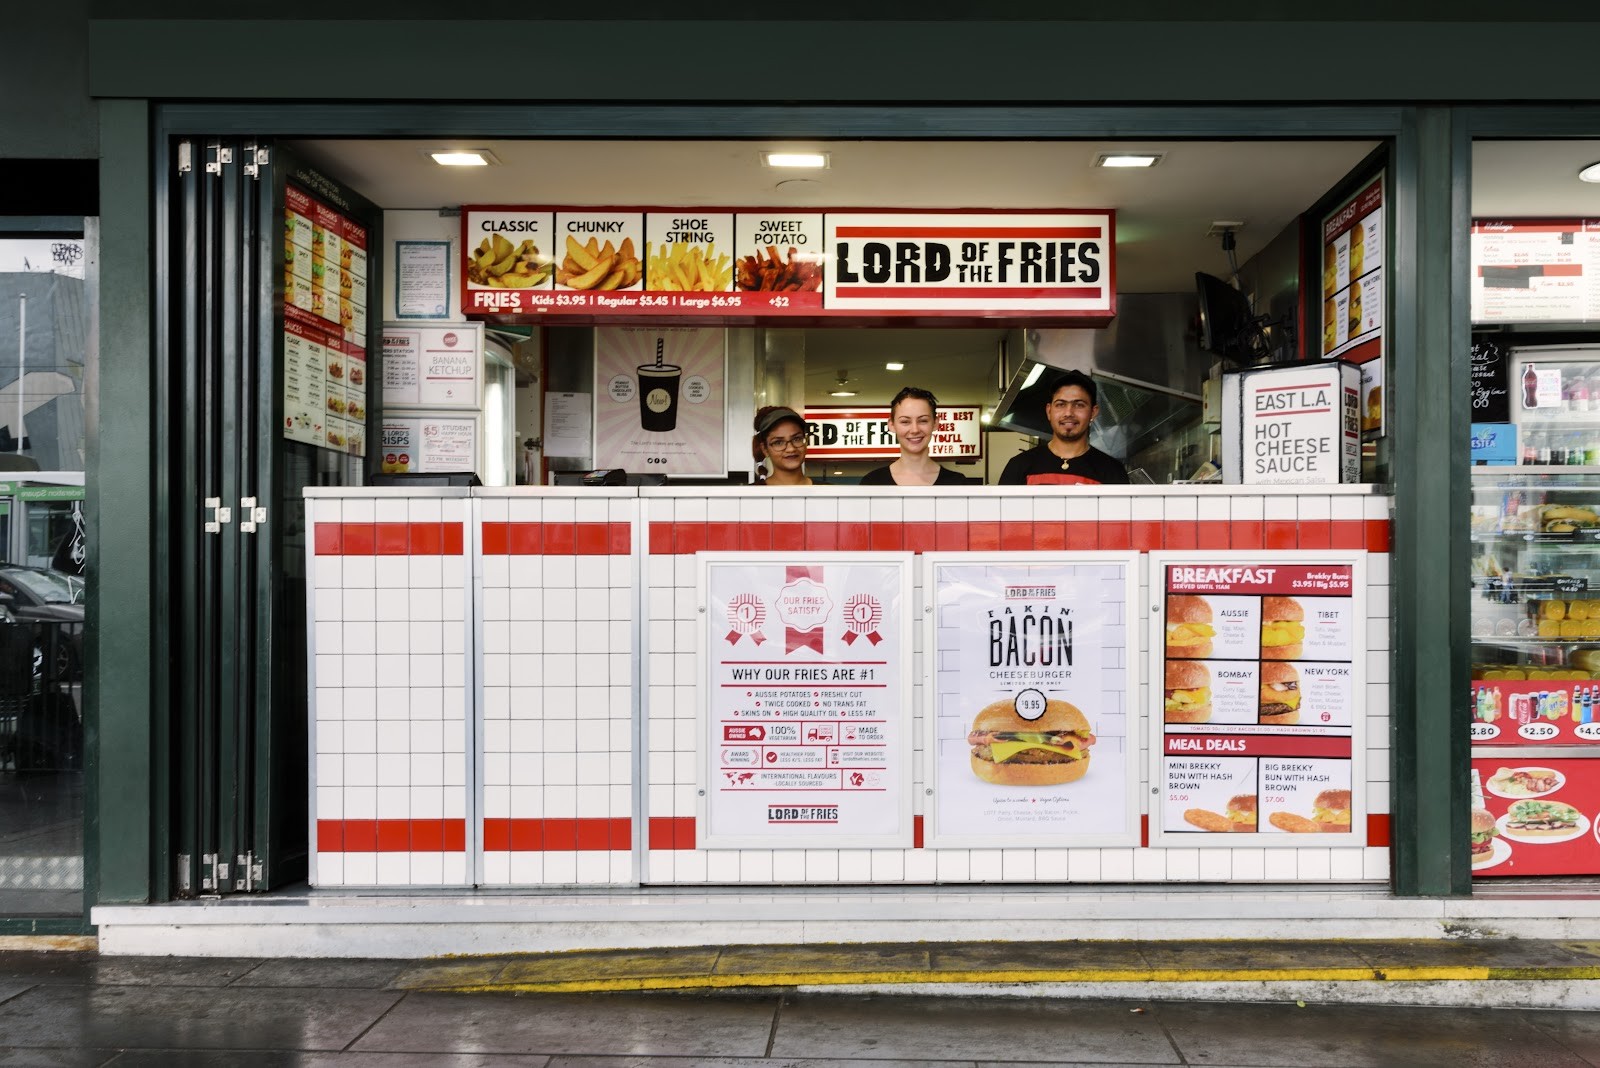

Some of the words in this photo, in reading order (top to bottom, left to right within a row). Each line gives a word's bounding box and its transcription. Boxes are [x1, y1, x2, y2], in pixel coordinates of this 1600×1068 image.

[1326, 202, 1357, 232] BREAKFAST
[482, 220, 538, 232] CLASSIC
[567, 222, 624, 233] CHUNKY
[672, 219, 708, 230] SHOE
[759, 221, 802, 232] SWEET
[666, 232, 714, 243] STRING
[755, 234, 807, 244] POTATO
[961, 242, 989, 261] OF
[836, 242, 950, 283] LORD
[999, 242, 1100, 283] FRIES
[956, 264, 992, 282] THE
[474, 292, 520, 307] FRIES
[532, 295, 554, 305] Kids
[556, 294, 585, 306] $3.95
[598, 296, 638, 308] Regular
[639, 295, 668, 306] $5.45
[680, 296, 709, 308] Large
[711, 296, 742, 306] $6.95
[769, 297, 789, 308] +$2
[429, 366, 471, 374] KETCHUP
[1256, 393, 1296, 411] EAST
[1301, 390, 1331, 407] L.A.
[936, 412, 947, 421] HE
[954, 412, 973, 421] BEST
[846, 422, 861, 432] OF
[1345, 415, 1358, 432] FRIES
[424, 426, 438, 436] $5
[1256, 422, 1292, 439] HOT
[842, 435, 864, 446] THE
[933, 434, 962, 443] YOU'LL
[933, 445, 953, 454] EVER
[960, 445, 976, 454] TRY
[1256, 438, 1330, 456] CHEESE
[1256, 456, 1317, 473] SAUCE
[1172, 568, 1276, 584] BREAKFAST
[1292, 580, 1312, 588] $3.95
[1316, 581, 1328, 589] Big
[1005, 589, 1027, 597] LORD
[990, 615, 1072, 666] BACON
[732, 669, 761, 680] WHY
[766, 669, 790, 680] OUR
[795, 669, 828, 680] FRIES
[832, 669, 855, 680] ARE
[860, 669, 874, 680] #1
[990, 671, 1072, 679] CHEESEBURGER
[1022, 700, 1040, 709] $9.95
[771, 726, 795, 734] 100%
[1169, 739, 1203, 750] MEAL
[1206, 739, 1246, 751] DEALS
[1265, 784, 1297, 792] BROWN
[768, 809, 798, 819] LORD
[810, 809, 838, 819] FRIES
